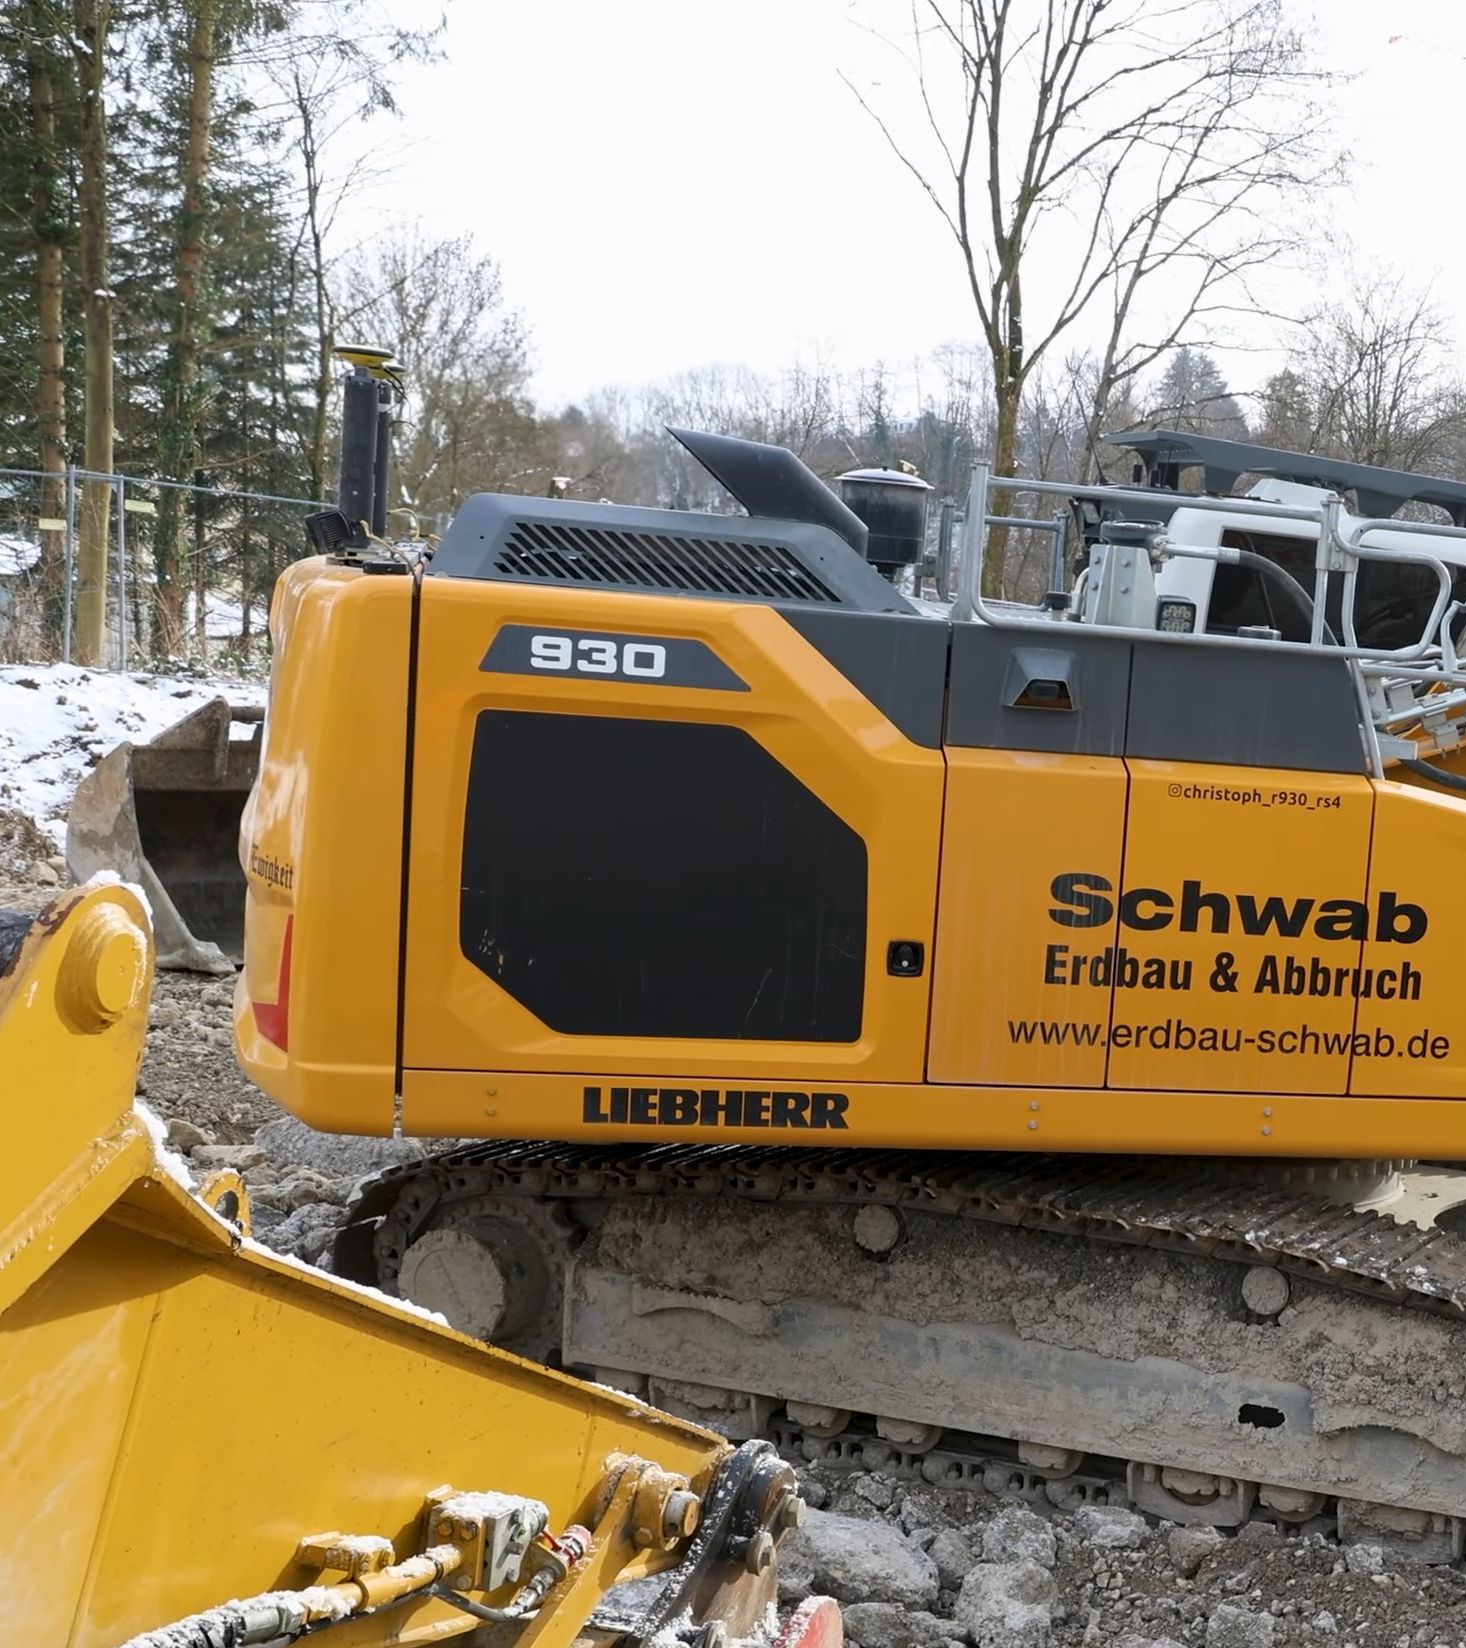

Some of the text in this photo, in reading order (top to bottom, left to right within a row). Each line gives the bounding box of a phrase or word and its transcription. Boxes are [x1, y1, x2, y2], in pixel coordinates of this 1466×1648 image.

[530, 634, 666, 678] 930
[1047, 872, 1429, 945] Schwab
[1043, 944, 1422, 1001] Erdbau & Abbruch
[1007, 1018, 1450, 1059] www.erdbau-schwab.de
[582, 1086, 850, 1129] LIEBHERR
